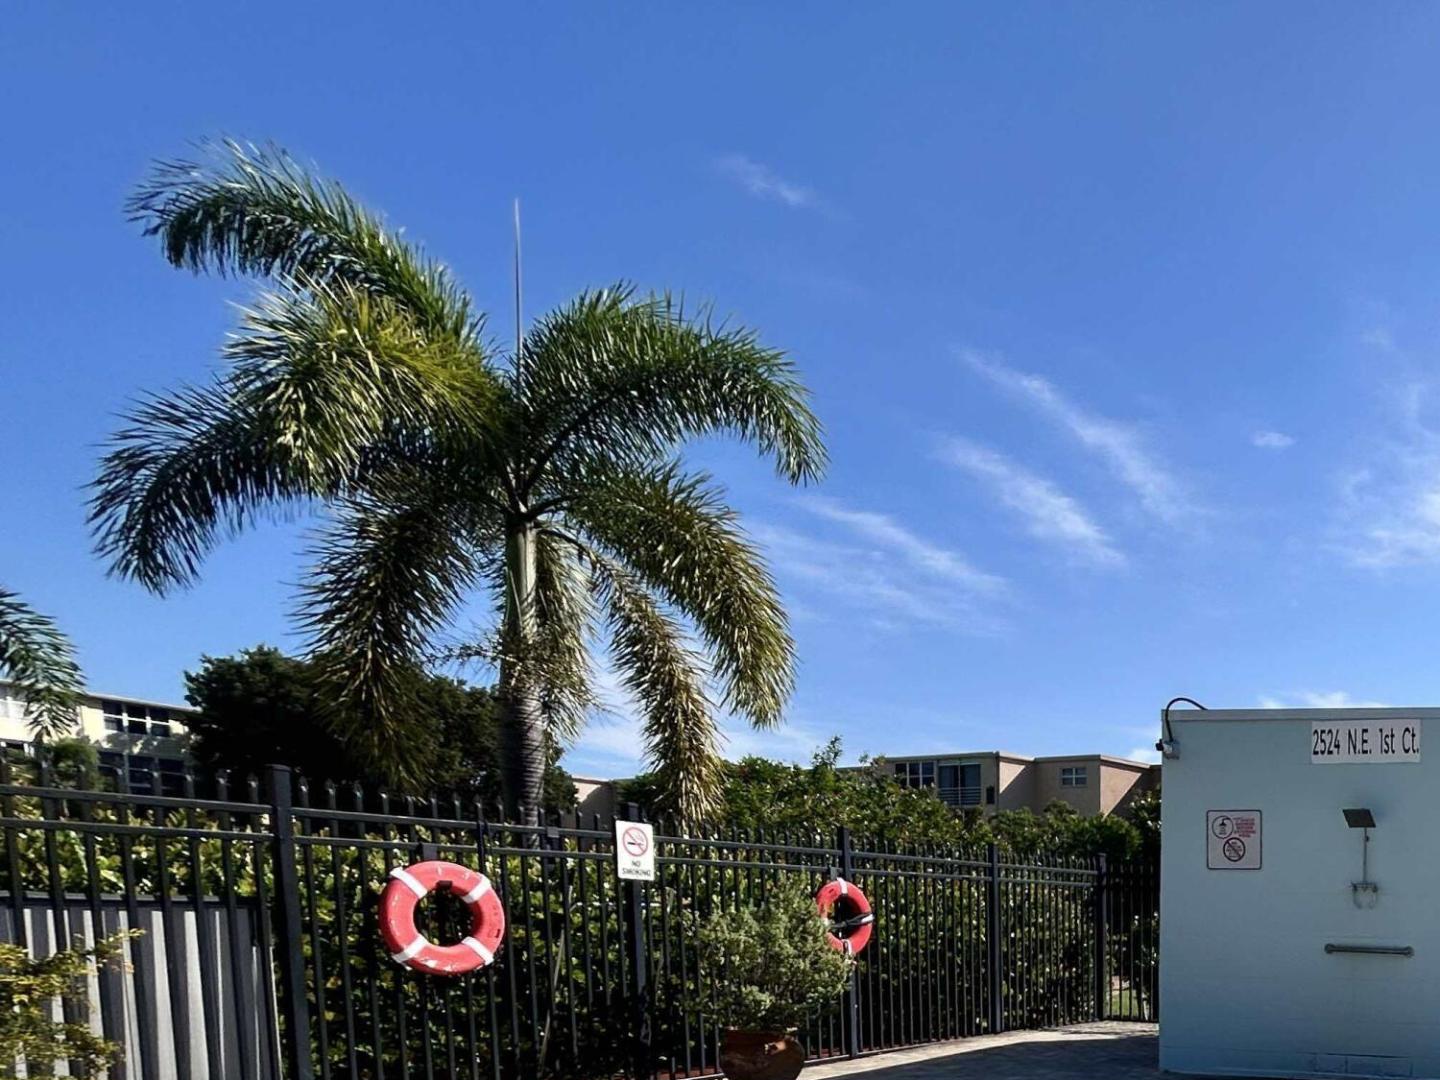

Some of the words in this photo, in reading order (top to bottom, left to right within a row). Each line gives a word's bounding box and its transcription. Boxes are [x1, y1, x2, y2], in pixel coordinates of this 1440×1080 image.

[1313, 729, 1340, 755] 2524
[1348, 728, 1372, 755] N.E.
[1379, 728, 1395, 754] 1st
[1402, 727, 1419, 754] Ct.
[622, 868, 651, 877] SMOKING
